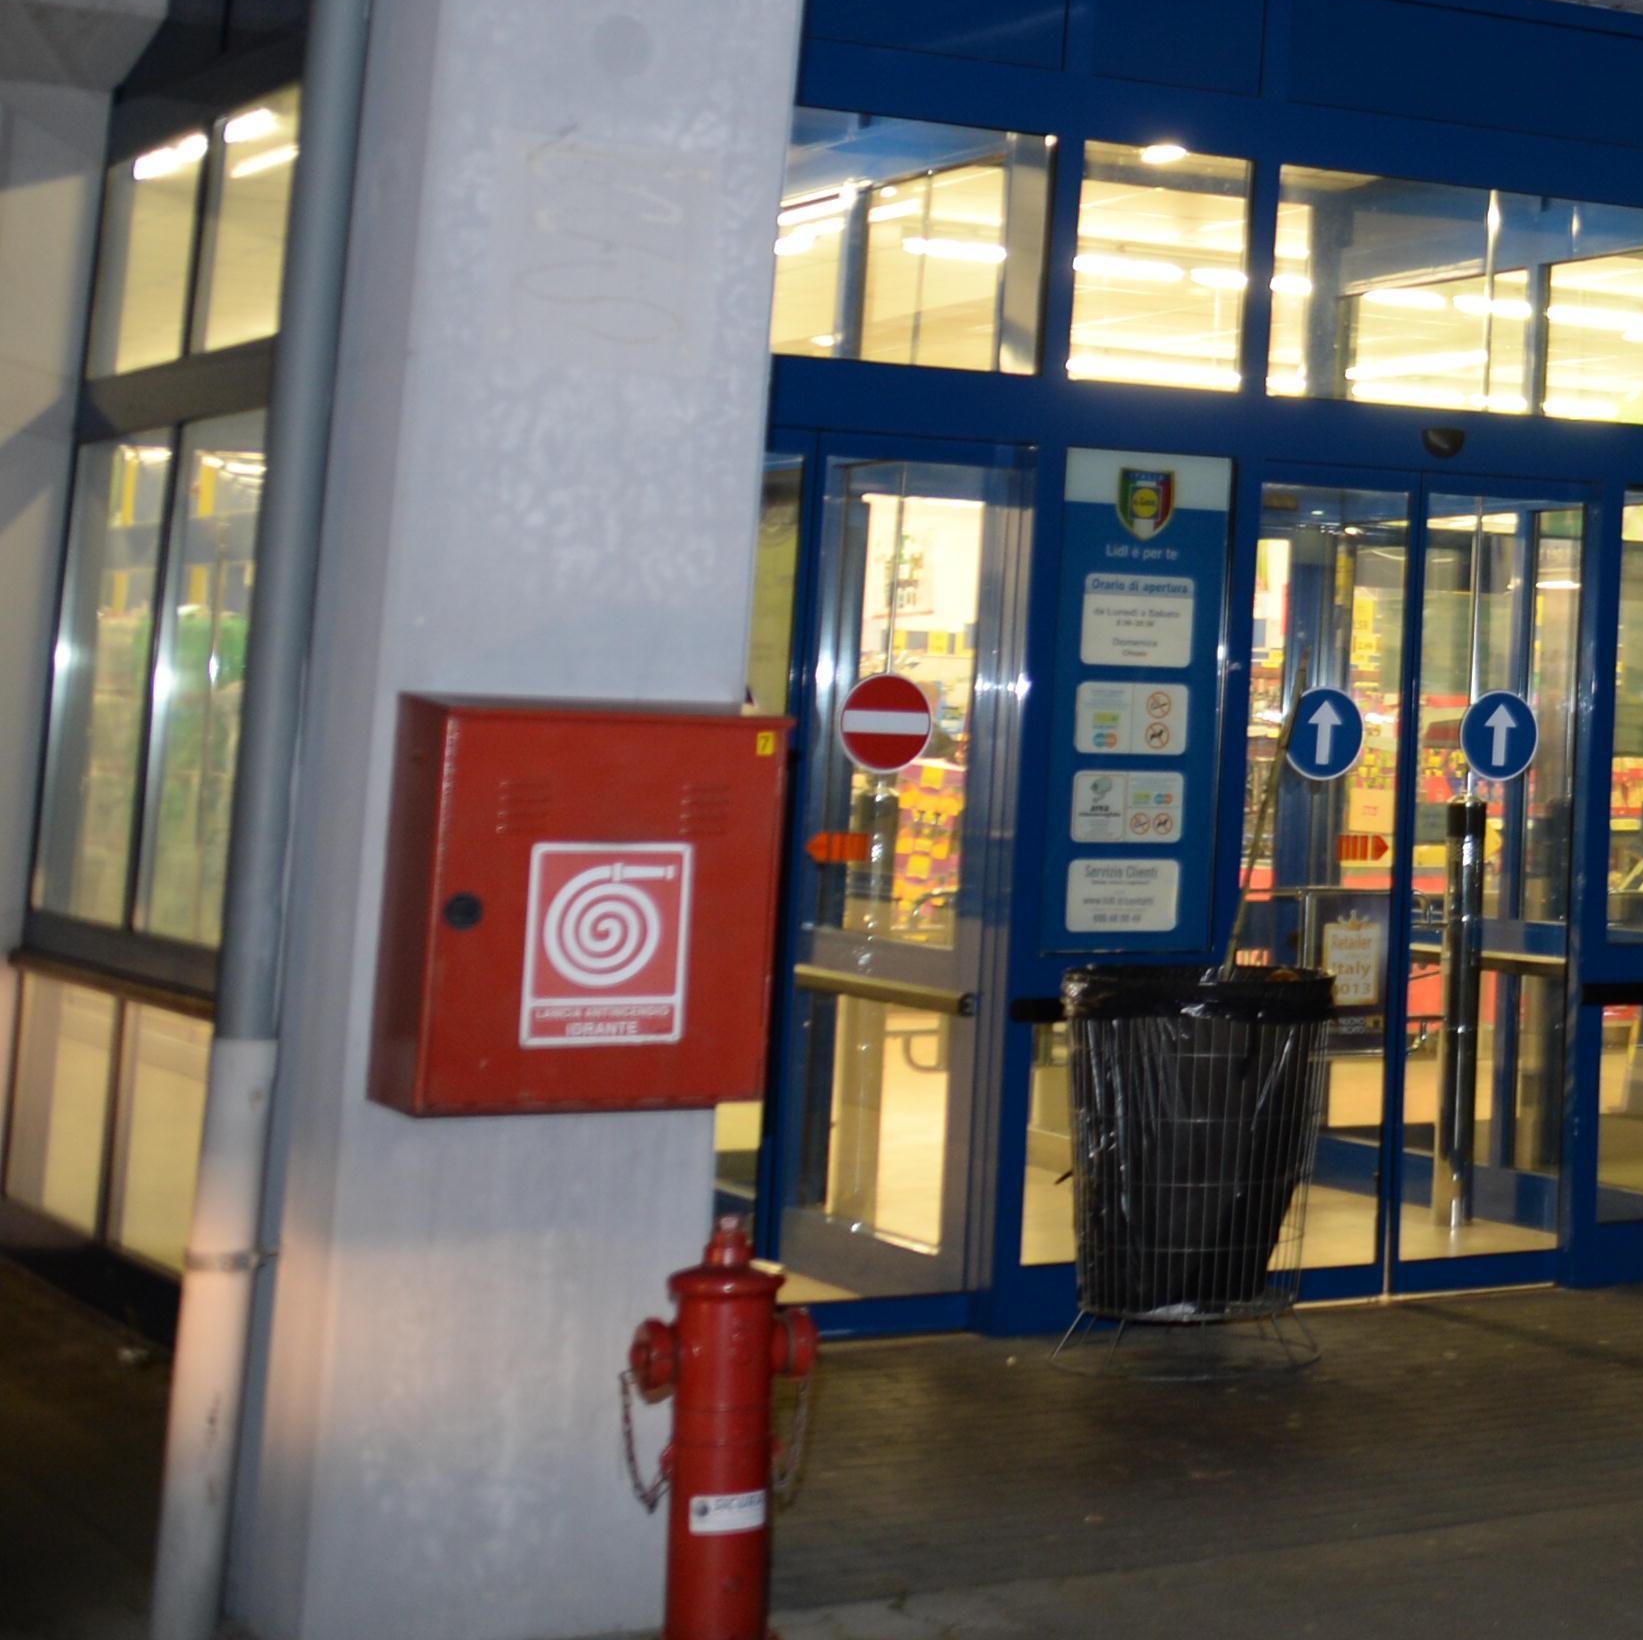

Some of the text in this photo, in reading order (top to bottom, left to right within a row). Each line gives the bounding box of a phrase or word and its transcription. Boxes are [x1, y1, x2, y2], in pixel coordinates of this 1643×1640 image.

[1105, 544, 1129, 557] Lidl
[1142, 549, 1162, 560] per
[1165, 549, 1178, 560] te
[1091, 577, 1188, 594] Orario di apertura
[1085, 864, 1158, 879] Servizio Clienti
[565, 1020, 639, 1037] IDRANTE
